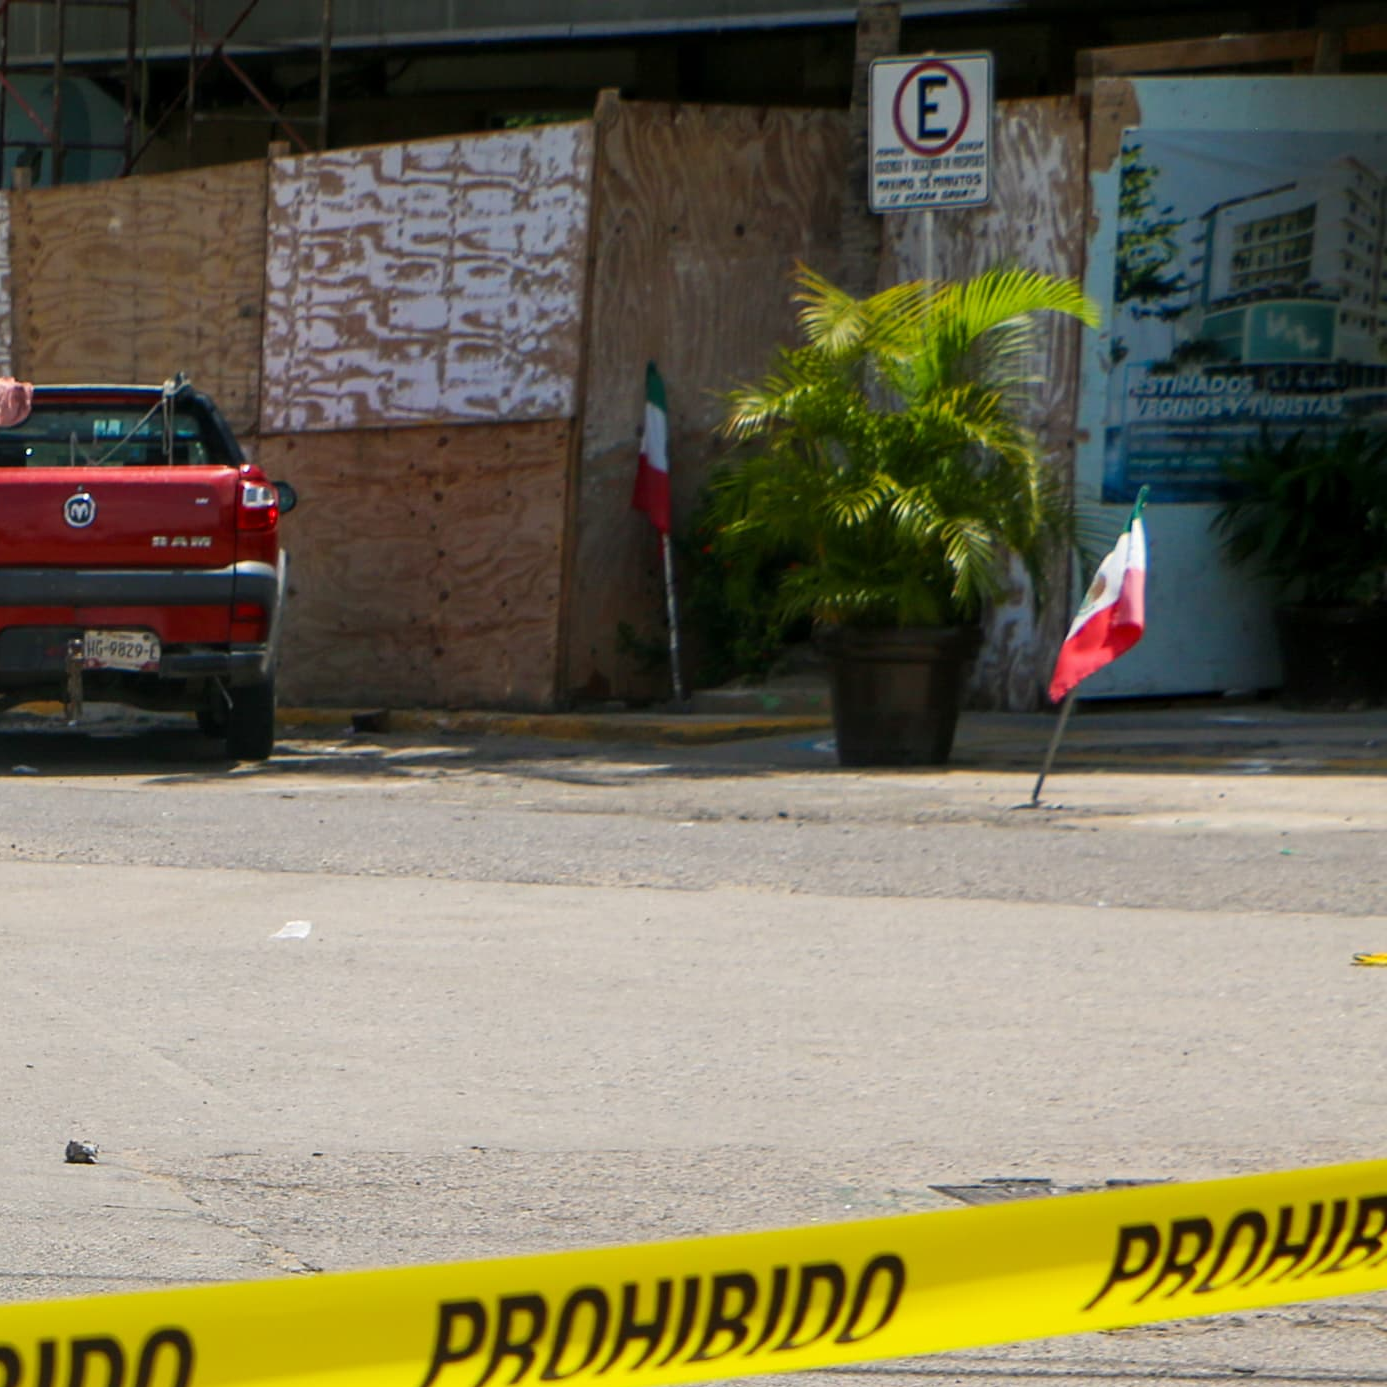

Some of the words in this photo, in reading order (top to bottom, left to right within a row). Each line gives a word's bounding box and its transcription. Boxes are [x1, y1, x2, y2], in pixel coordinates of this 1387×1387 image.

[917, 74, 948, 139] E
[932, 174, 982, 188] MINUTOS
[1246, 395, 1343, 416] TURISTAS
[152, 536, 212, 547] RAM
